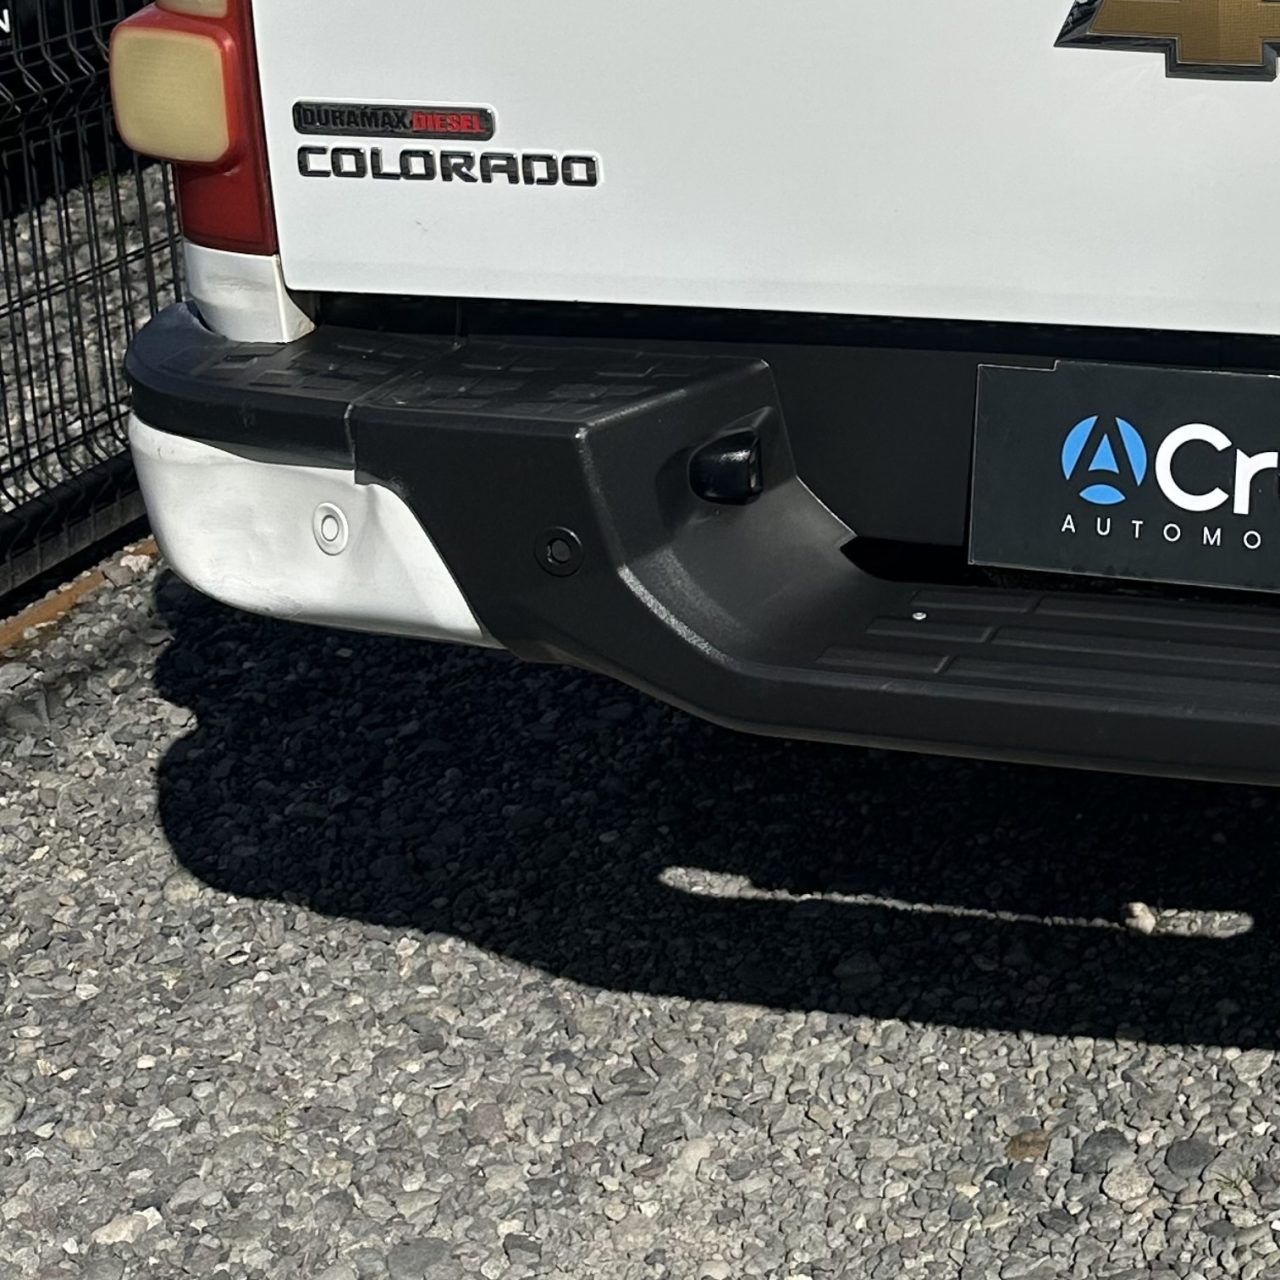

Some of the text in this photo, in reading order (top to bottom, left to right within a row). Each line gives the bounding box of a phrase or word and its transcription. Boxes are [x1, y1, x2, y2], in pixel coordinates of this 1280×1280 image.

[301, 106, 486, 133] DURAMAX DIESEL
[297, 146, 599, 187] COLORADO
